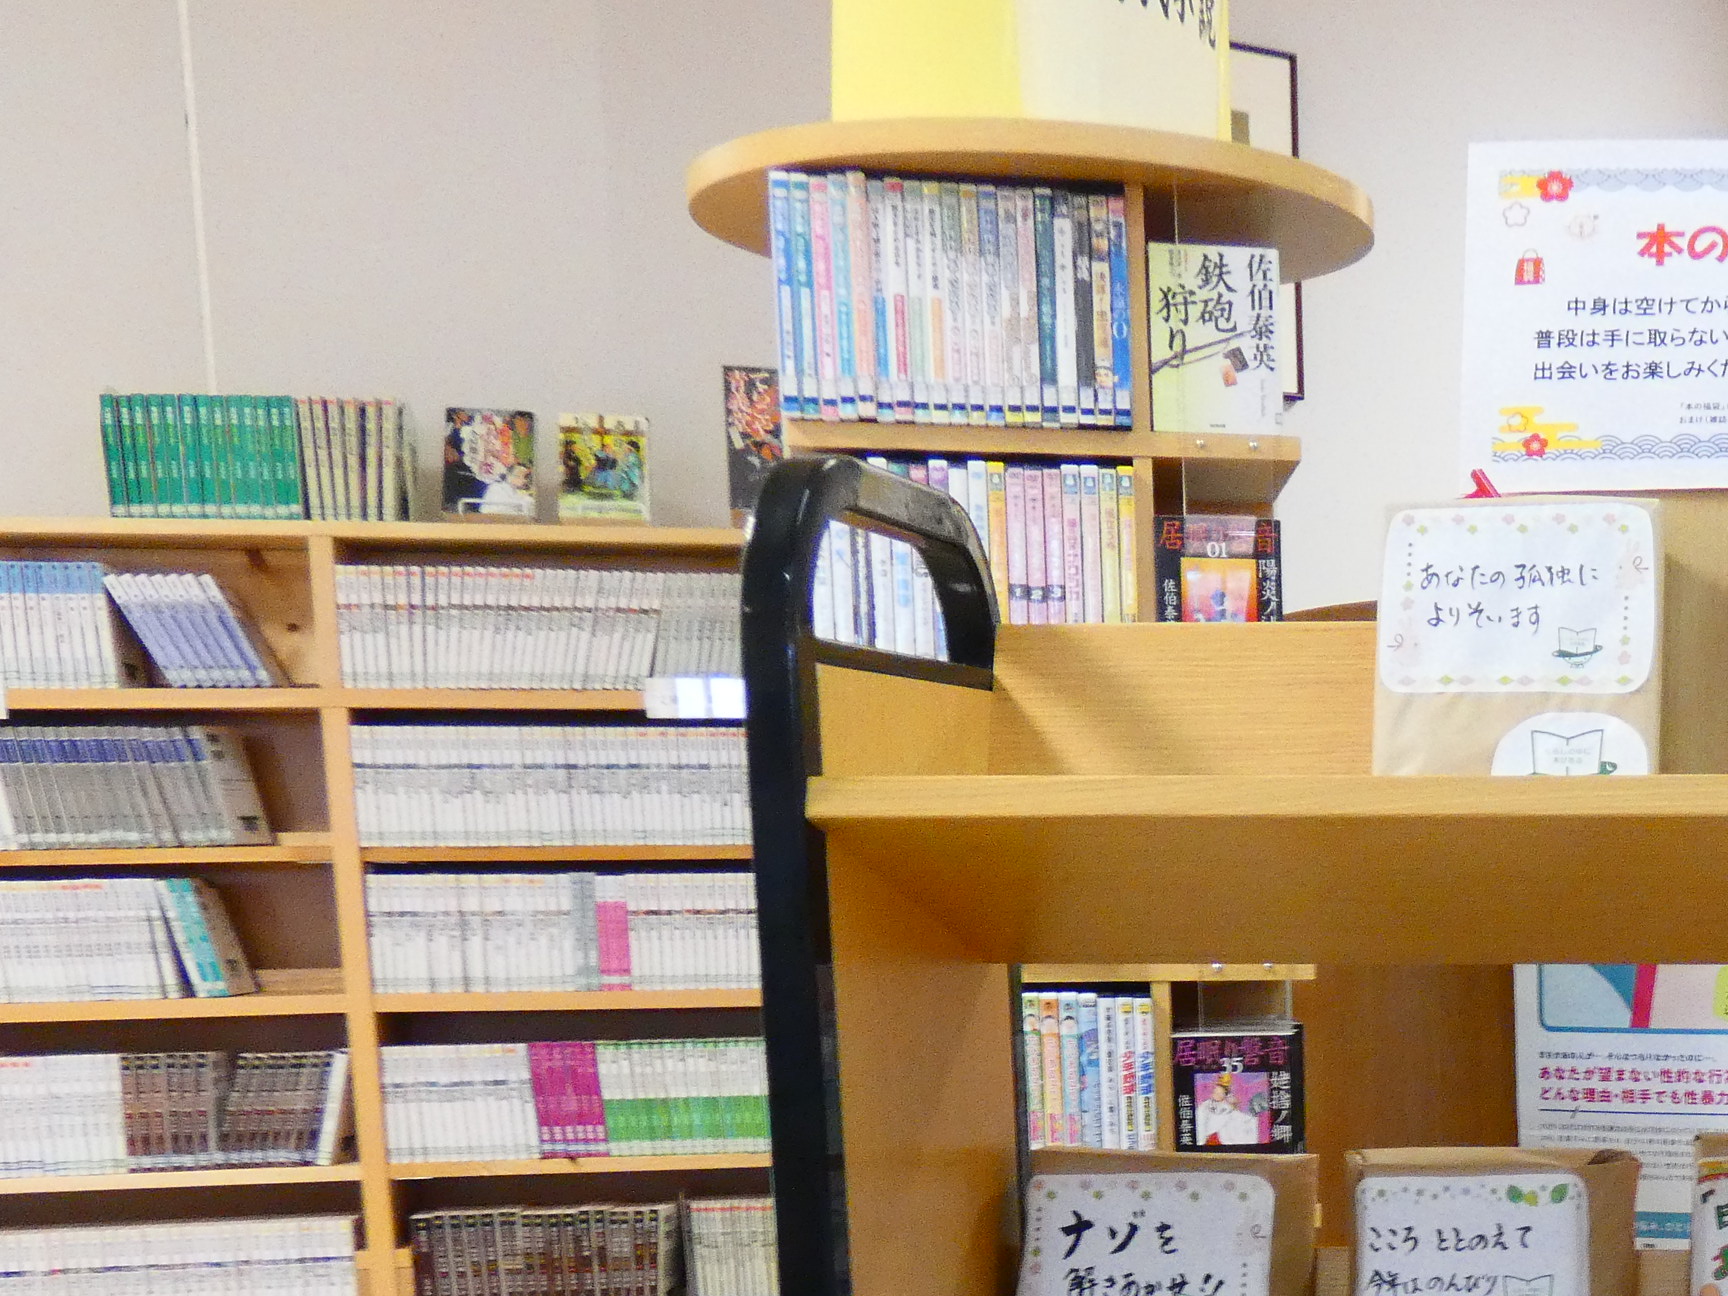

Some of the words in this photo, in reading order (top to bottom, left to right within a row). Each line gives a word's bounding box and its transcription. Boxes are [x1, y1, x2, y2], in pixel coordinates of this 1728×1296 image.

[1195, 252, 1238, 333] 鉄砲
[1248, 253, 1276, 372] 佐伯泰英
[1156, 283, 1198, 366] 狩り
[1206, 541, 1228, 558] 01
[1258, 559, 1279, 622] 陽炎ノ
[1426, 601, 1542, 635] よりそいます
[1219, 1057, 1244, 1074] 35
[1059, 1209, 1182, 1260] ナゾを
[1368, 1226, 1420, 1252] こころ
